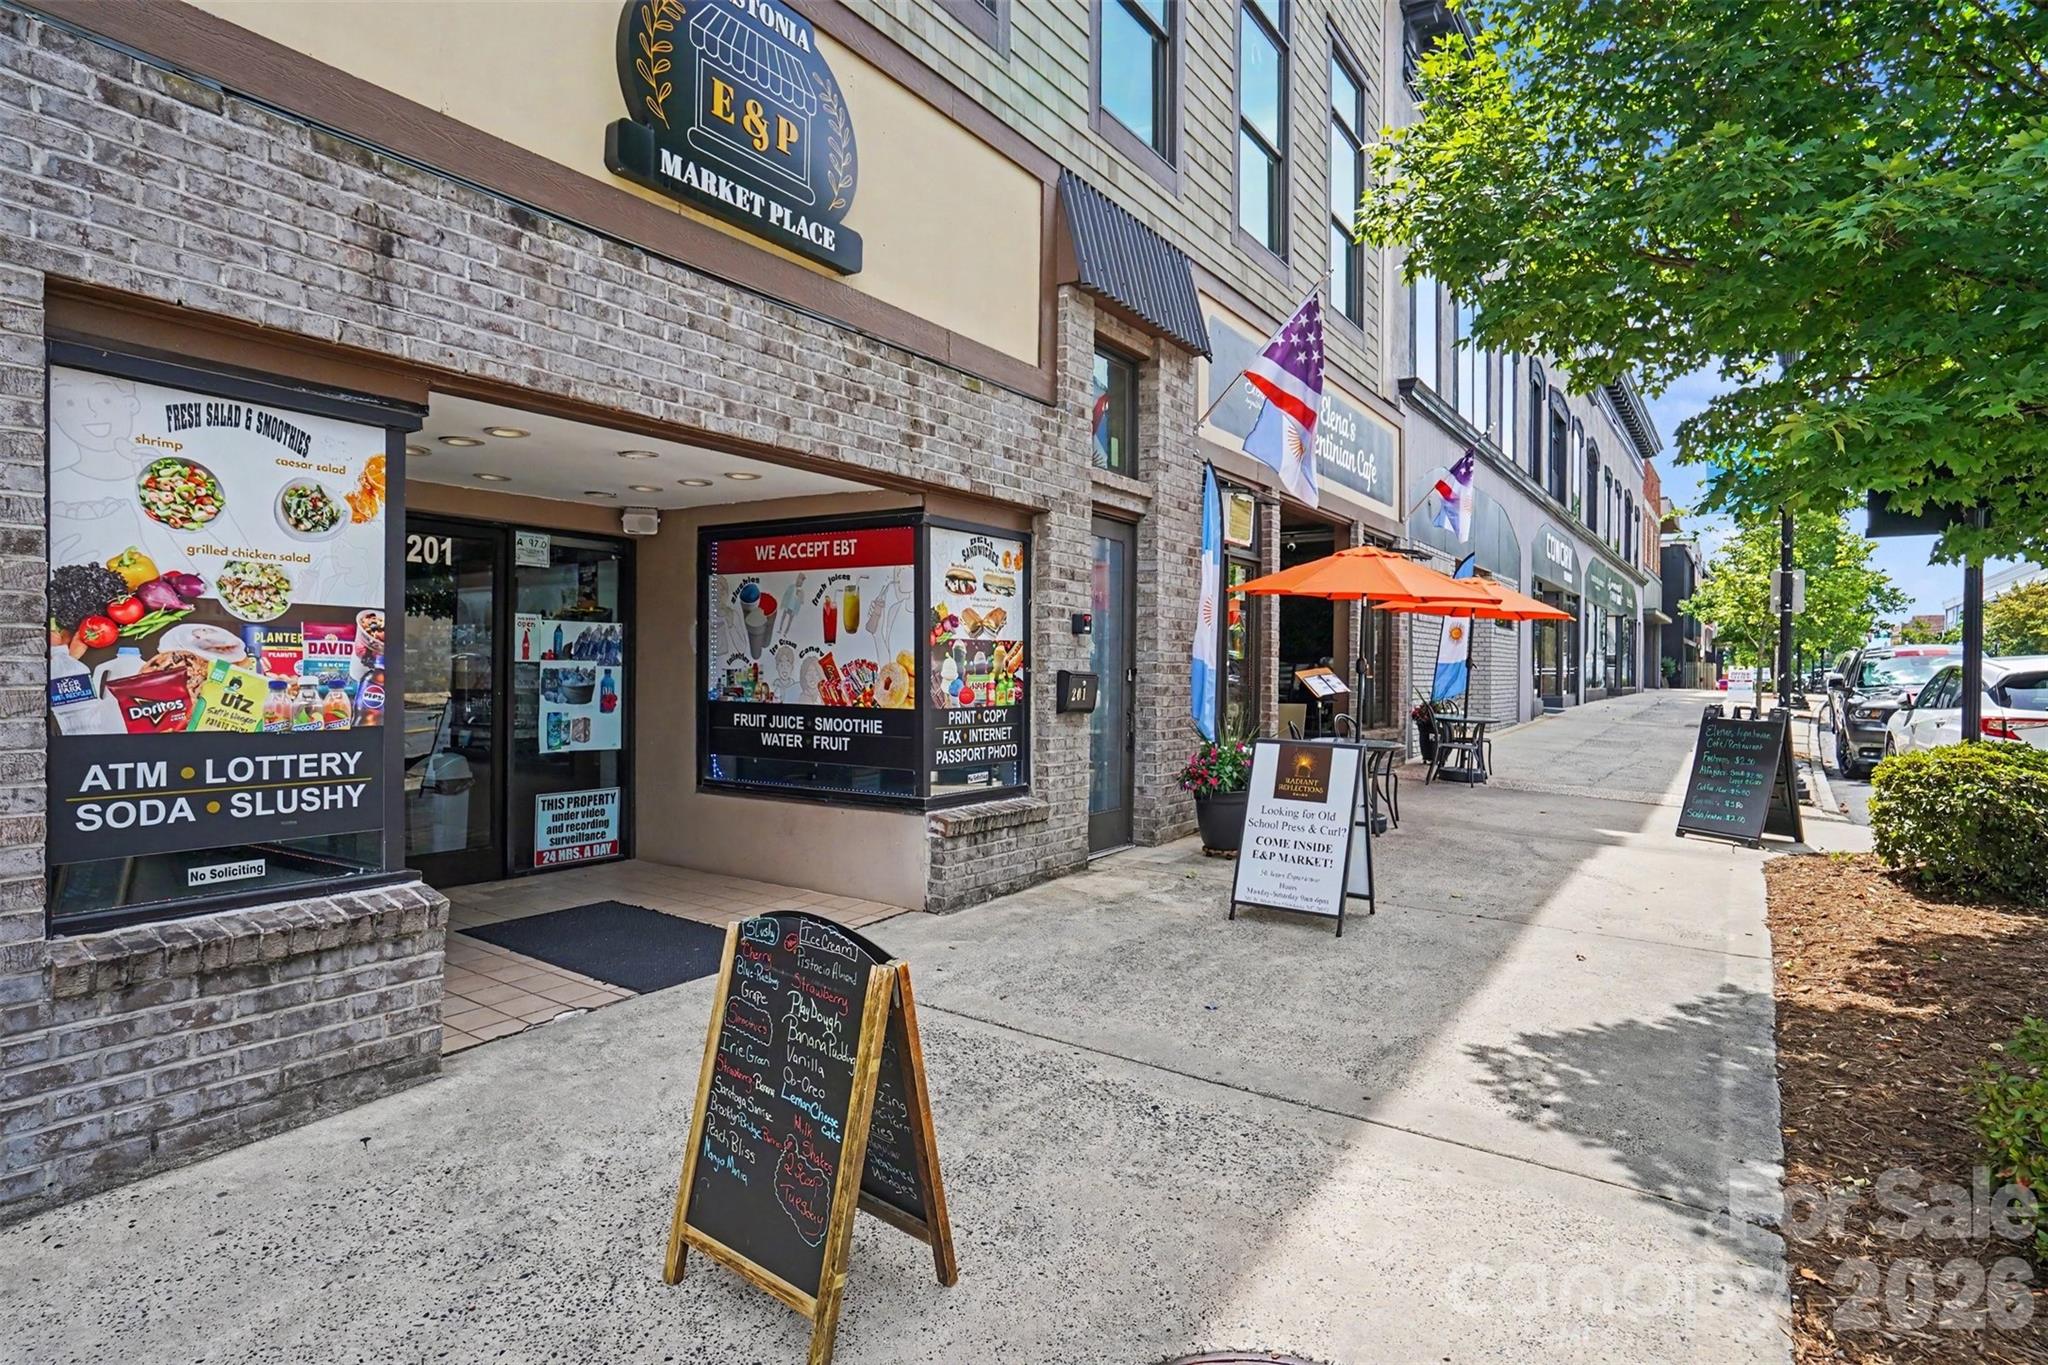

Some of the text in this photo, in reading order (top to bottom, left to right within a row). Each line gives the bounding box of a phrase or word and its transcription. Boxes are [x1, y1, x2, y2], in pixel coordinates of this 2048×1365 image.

[659, 148, 836, 252] MARKET PLACE
[1320, 395, 1356, 442] Elena's
[165, 402, 312, 459] FRESH SALAD & SMOOTHIES
[135, 434, 183, 452] shrimp
[275, 457, 346, 475] caesar salad
[406, 533, 452, 566] 201
[755, 538, 858, 561] WE ACCEPT EBT
[970, 536, 994, 550] DELI
[187, 545, 312, 565] grilled chicken salad
[268, 651, 298, 659] PEANUTS
[308, 641, 353, 655] DAVID
[1071, 687, 1087, 702] 201
[129, 699, 185, 720] Doritos
[948, 709, 1008, 725] PRINT COPY
[733, 713, 883, 734] FRUIT JUICE SMOOTHIE
[761, 732, 850, 752] WATER FRUIT
[942, 726, 1012, 744] FAX INTERNET
[936, 744, 1018, 765] PASSPORT PHOTO
[79, 751, 364, 793] ATM LOTTERY
[75, 783, 366, 831] SODA SLUSHY
[541, 792, 616, 811] THIS PROPERTY
[552, 808, 606, 822] under video
[1261, 804, 1336, 822] Looking for Old
[546, 819, 610, 835] and recording
[1248, 817, 1348, 838] School Press & Curl?
[549, 831, 607, 846] surveillance
[1255, 836, 1333, 854] COME INSIDE
[543, 843, 612, 864] 24 HRS. A DAY
[1252, 850, 1334, 869] E&P MARKET!
[190, 861, 264, 882] No Soliciting
[746, 920, 776, 943] Slushy
[743, 944, 772, 971] Cherry
[741, 980, 769, 1006] Grape
[791, 972, 849, 1016] Strawberry
[781, 1013, 827, 1056] Banana
[787, 1044, 825, 1079] Vanilla
[794, 1113, 815, 1138] Milk
[705, 1111, 756, 1165] Peach Bliss
[803, 1141, 834, 1176] Shakes
